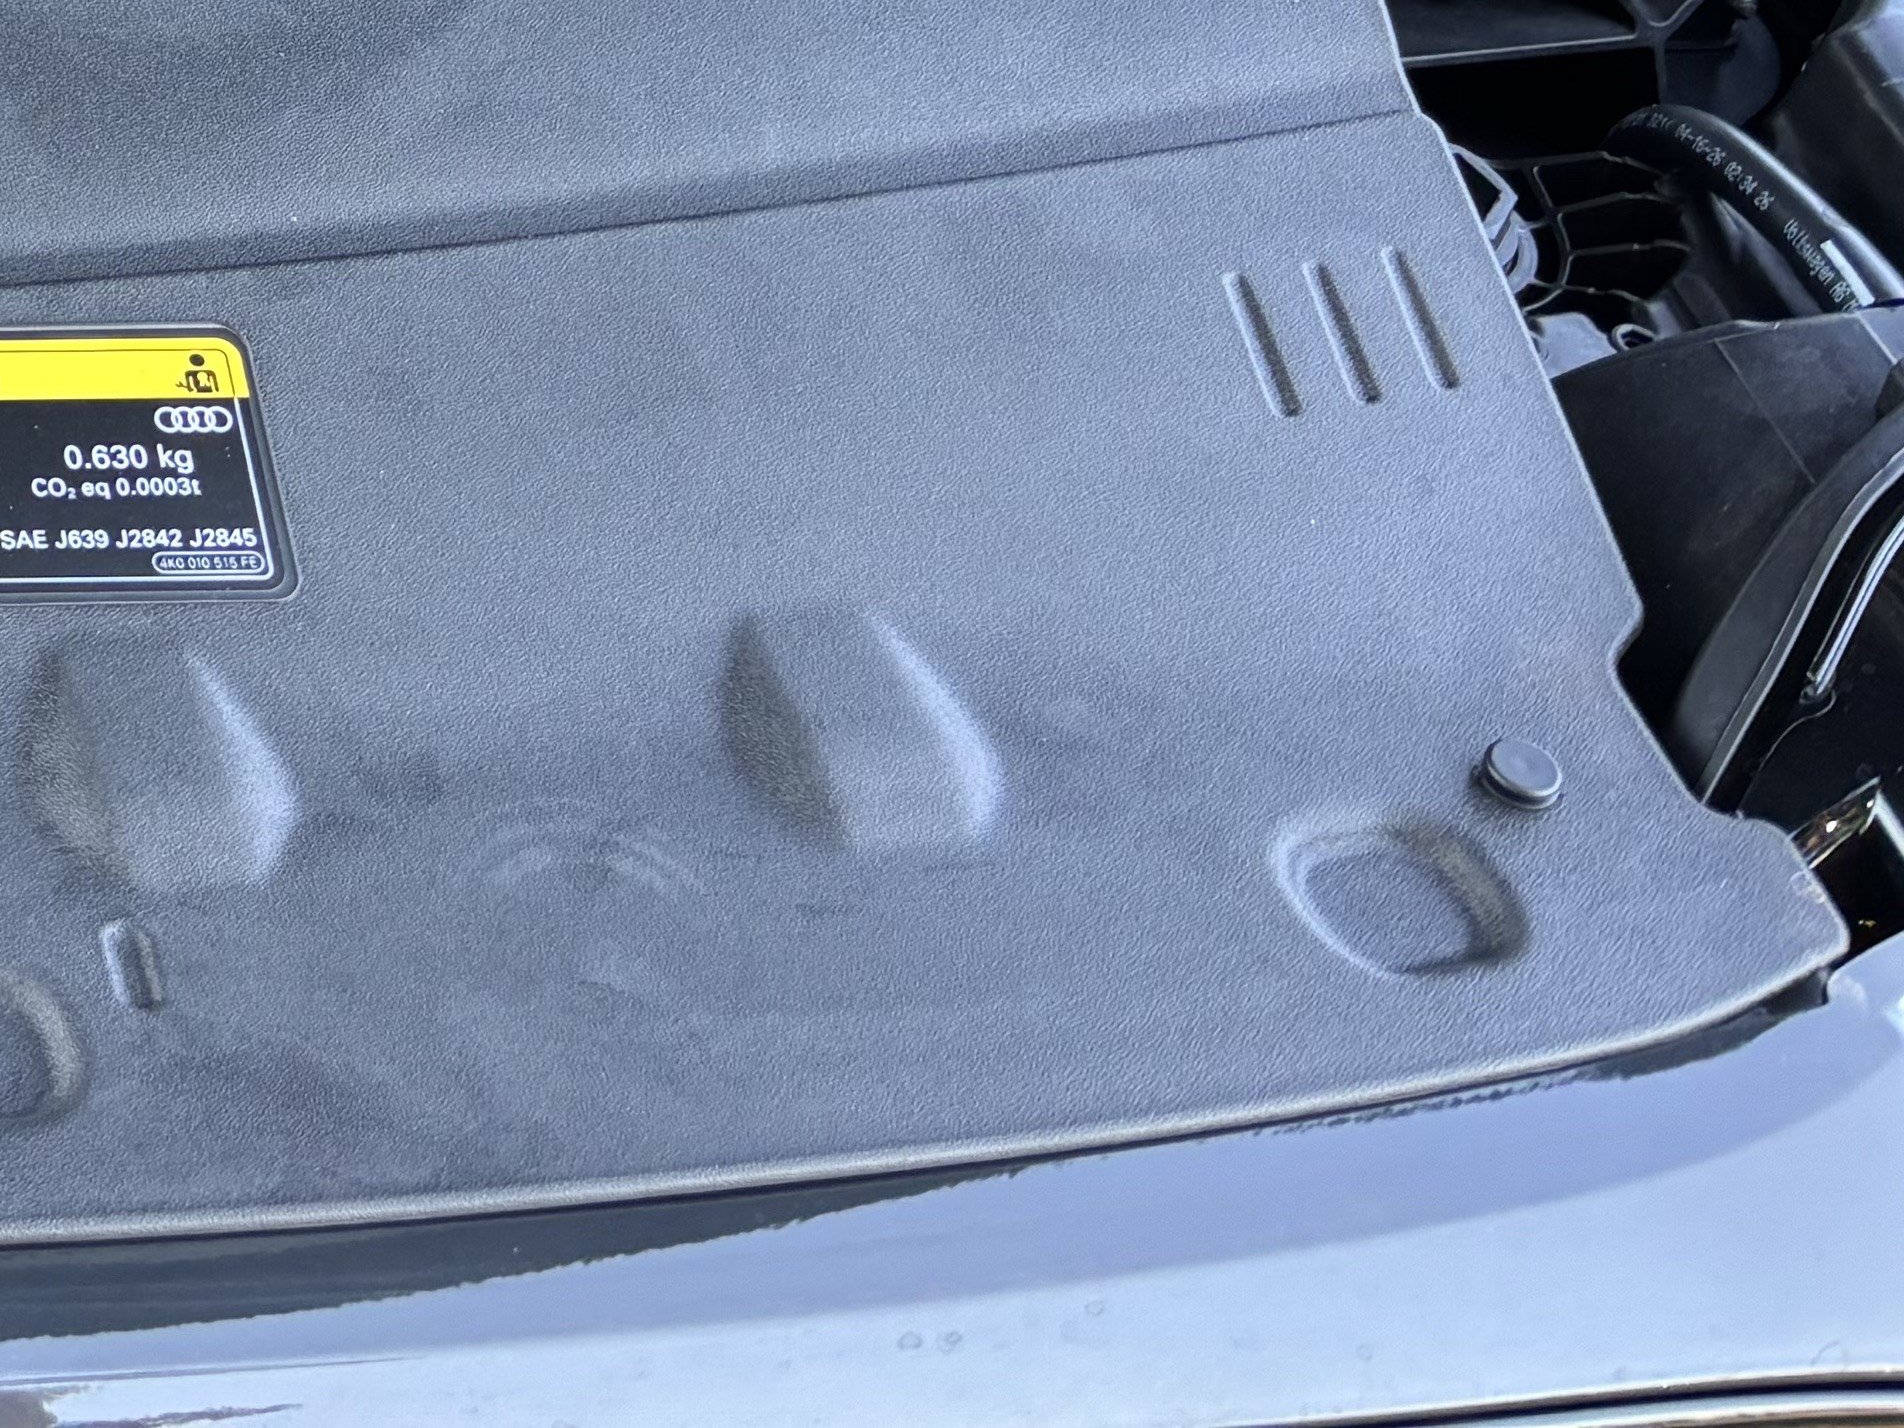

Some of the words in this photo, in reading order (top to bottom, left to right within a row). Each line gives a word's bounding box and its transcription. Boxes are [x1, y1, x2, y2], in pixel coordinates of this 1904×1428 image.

[64, 444, 148, 471] 0.630
[157, 444, 194, 475] kg
[82, 481, 111, 500] eq
[116, 477, 202, 498] 0.0003t
[0, 531, 49, 550] SAE
[55, 530, 109, 550] J639
[116, 529, 183, 549] J2842
[190, 528, 257, 548] J2845
[159, 557, 185, 569] 4K0
[187, 557, 210, 569] 010
[213, 556, 238, 569] 515
